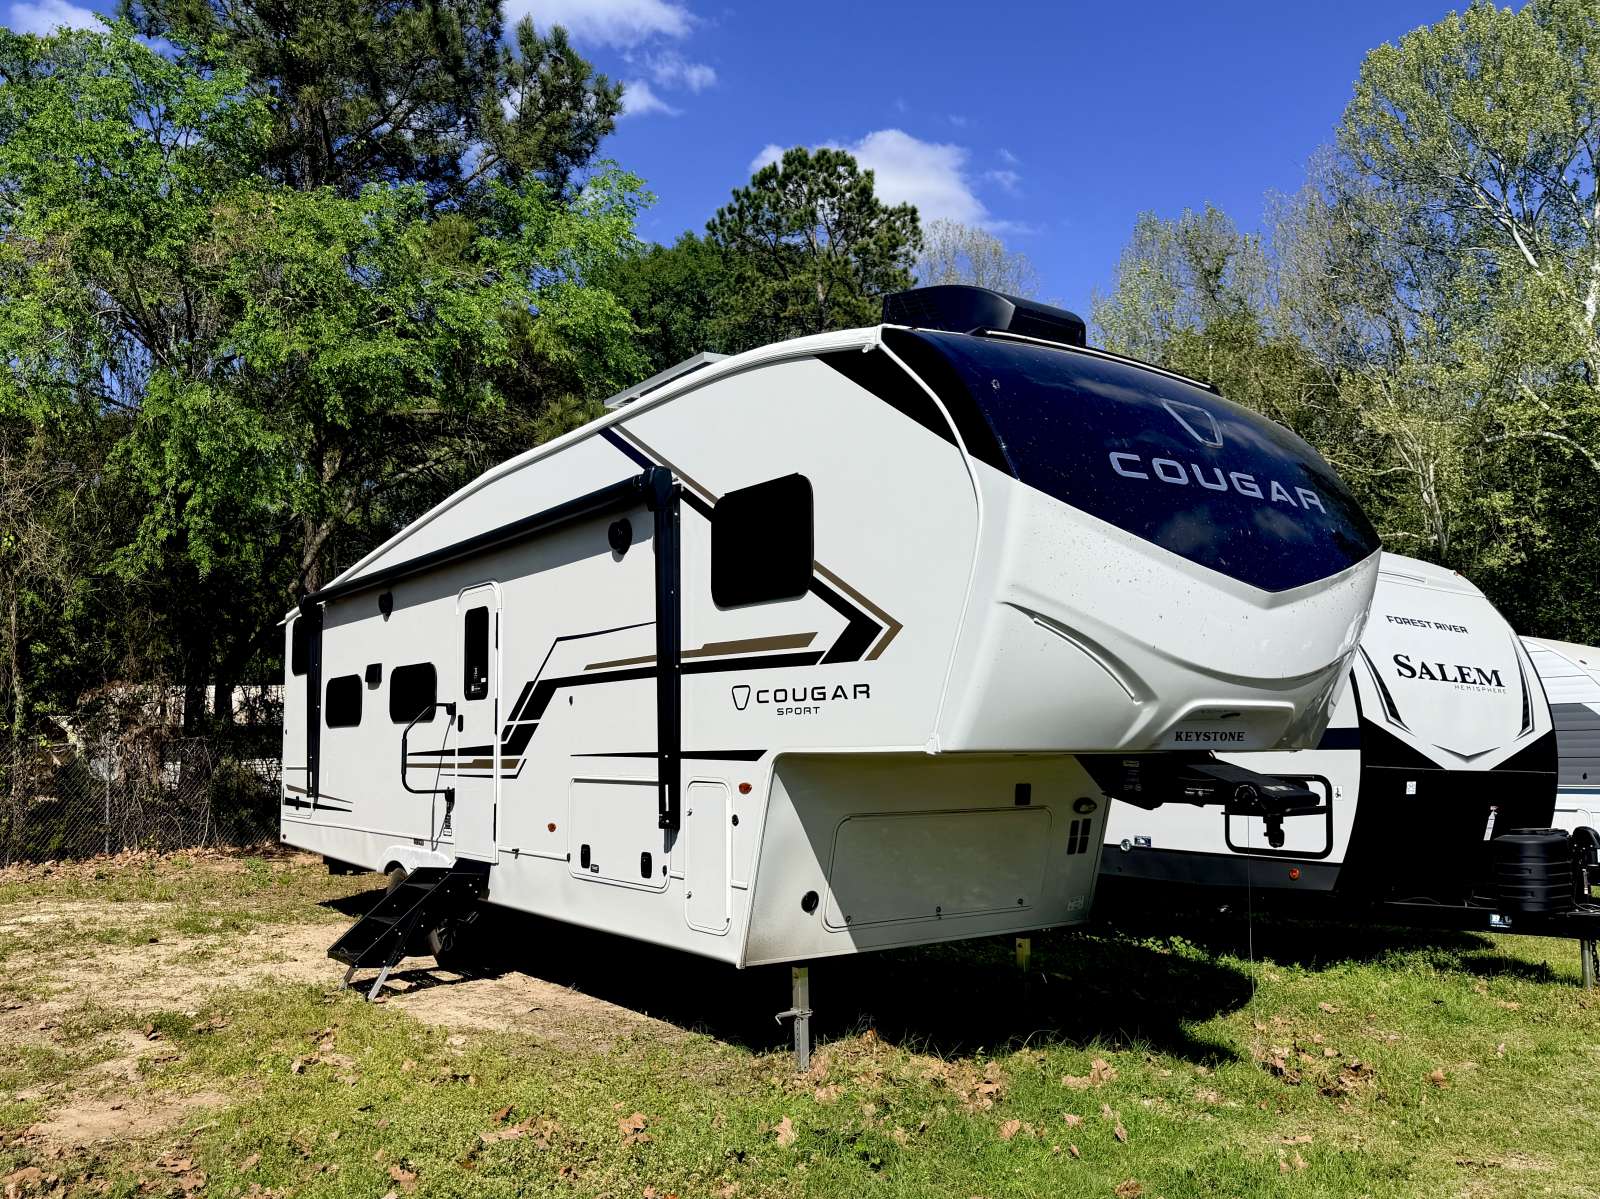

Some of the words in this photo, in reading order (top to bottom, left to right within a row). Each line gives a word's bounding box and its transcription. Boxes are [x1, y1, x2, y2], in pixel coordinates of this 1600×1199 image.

[1109, 451, 1327, 514] COUGAR
[1386, 615, 1432, 629] FOREST
[1433, 622, 1469, 634] RIVER
[1393, 653, 1506, 688] SALEM
[756, 683, 871, 703] COUGAR
[776, 706, 821, 716] SPORT
[1174, 731, 1246, 742] KEYSTONE
